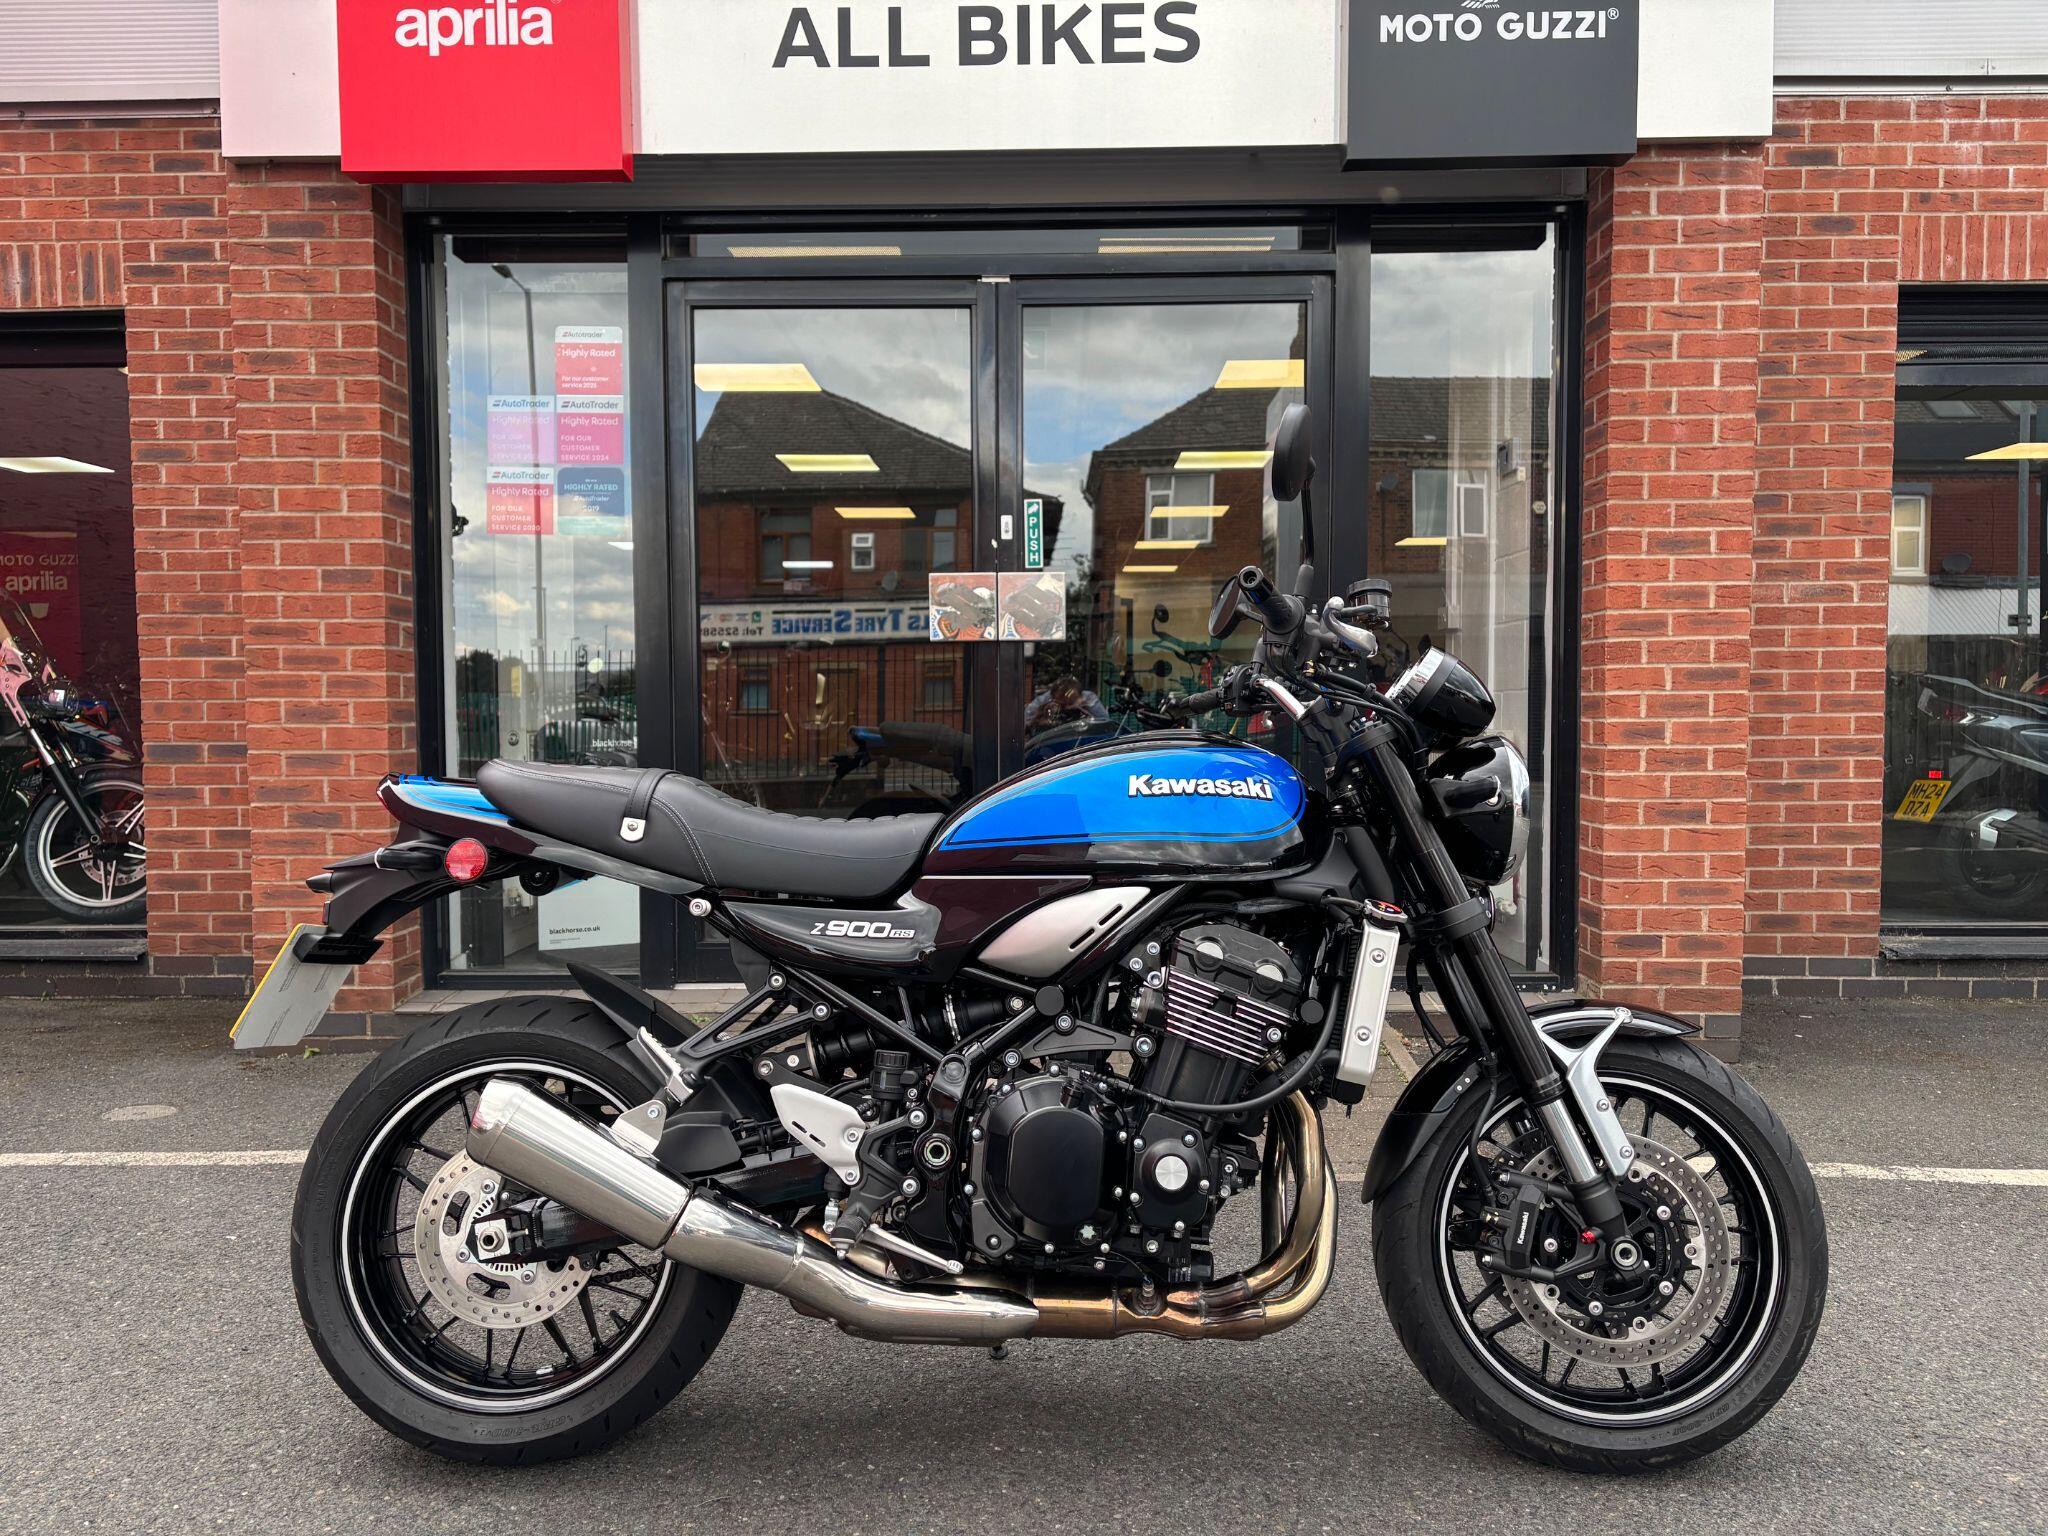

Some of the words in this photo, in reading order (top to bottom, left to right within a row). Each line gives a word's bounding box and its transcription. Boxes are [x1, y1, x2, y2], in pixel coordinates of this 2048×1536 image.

[394, 0, 554, 56] aprilia
[1379, 12, 1483, 43] MOTO
[772, 6, 931, 68] ALL
[958, 1, 1201, 66] BIKES
[561, 348, 589, 358] Highly
[590, 348, 616, 357] Rated
[500, 399, 550, 408] AutoTrader
[570, 400, 619, 409] AutoTrader
[492, 416, 521, 425] Highly
[561, 416, 590, 427] Highly
[591, 416, 618, 426] Rated
[500, 471, 550, 480] AutoTrader
[492, 487, 520, 497] Highly
[522, 487, 549, 496] Rated
[564, 483, 592, 491] HIGHLY
[582, 504, 600, 512] 2019
[1029, 517, 1039, 563] PUSH
[5, 570, 68, 595] aprilia
[1128, 774, 1274, 801] Kawasaki
[1907, 783, 1946, 800] MH24
[1903, 800, 1931, 817] DZA
[549, 925, 601, 935] blackhorse.co.uk
[1516, 1211, 1530, 1245] Kawasaki
